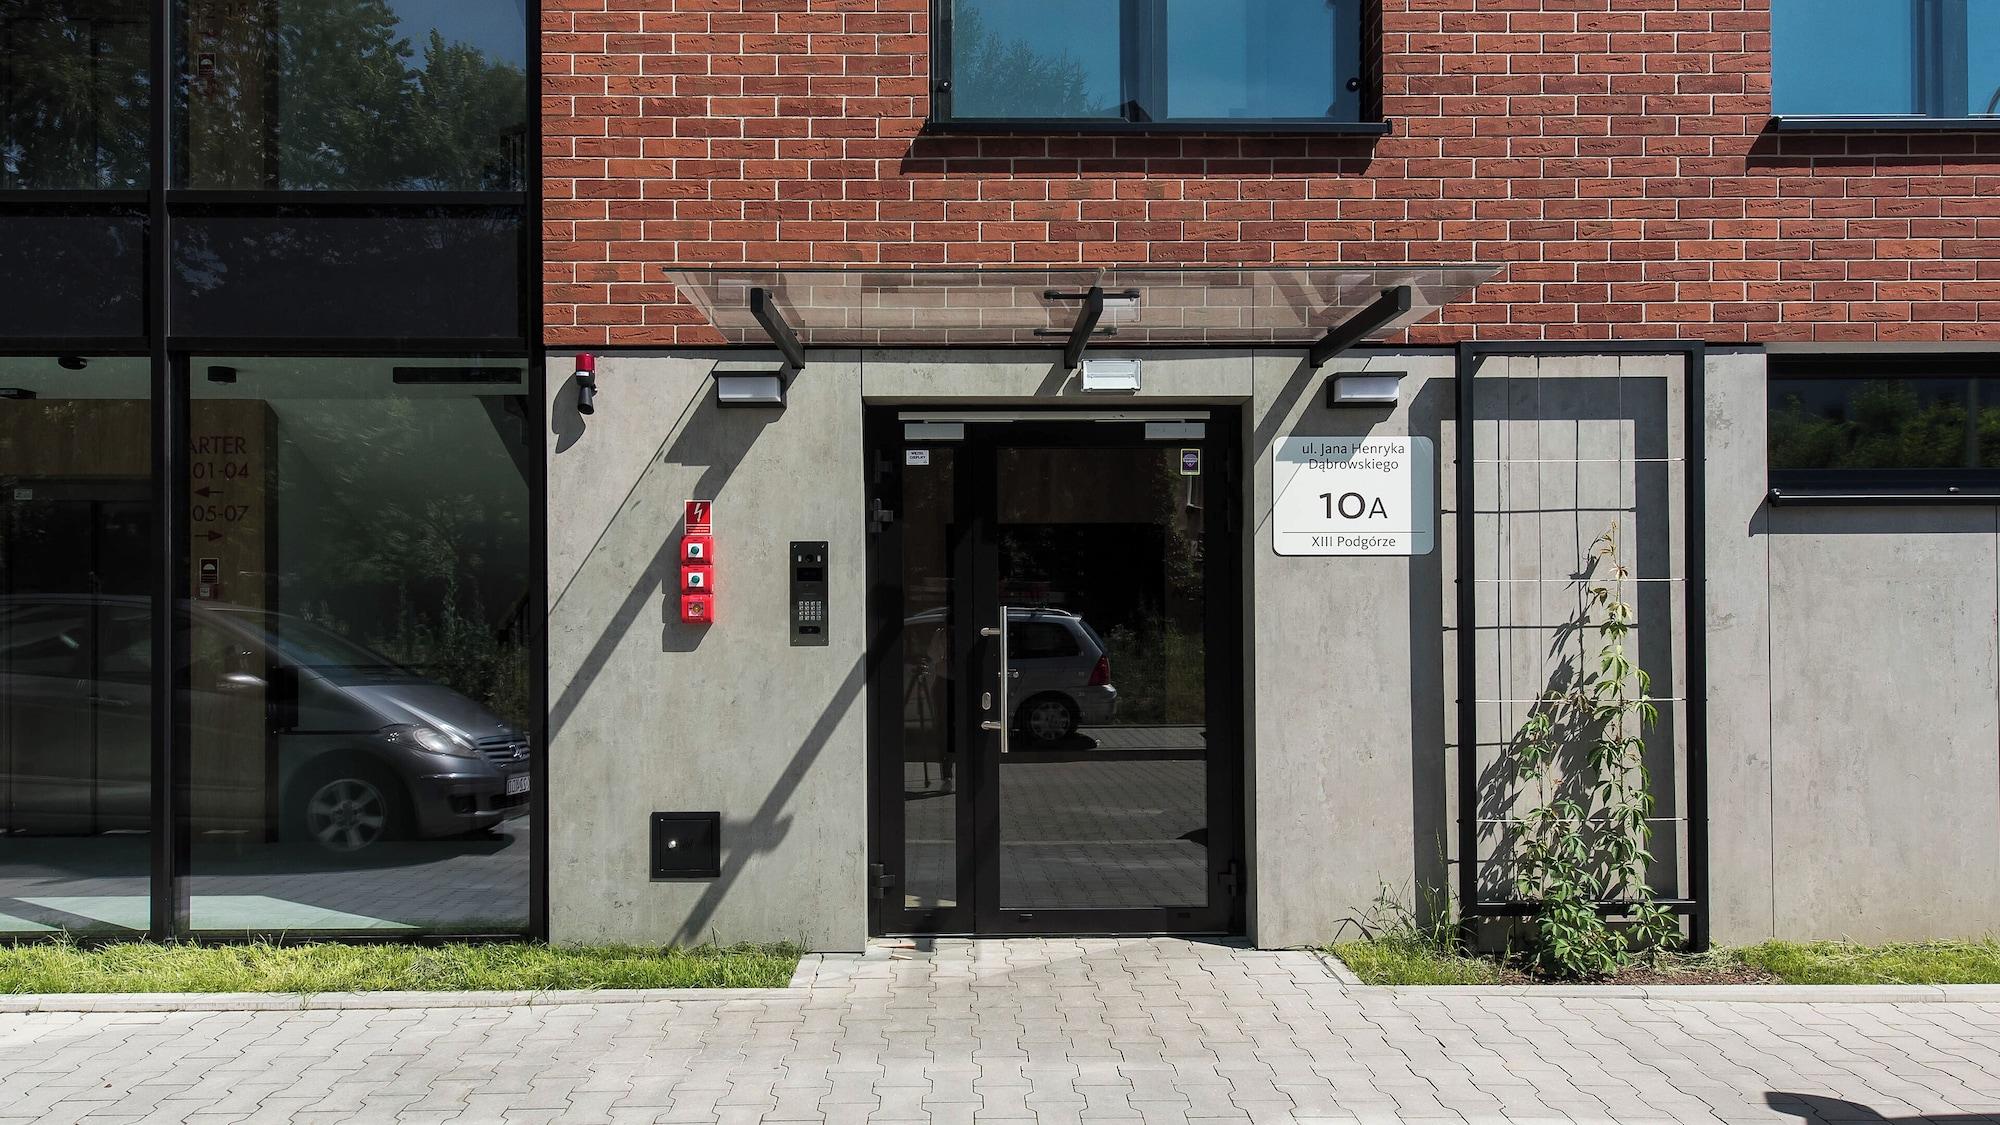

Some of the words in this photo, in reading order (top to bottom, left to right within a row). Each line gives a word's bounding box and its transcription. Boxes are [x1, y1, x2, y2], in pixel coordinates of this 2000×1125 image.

[1302, 442, 1317, 455] ul.
[1320, 442, 1348, 457] Jana
[1351, 442, 1405, 457] Henryka
[192, 462, 249, 479] 01-04
[1308, 458, 1399, 473] Dąbrowskiego
[192, 504, 249, 522] 05-07
[1319, 491, 1388, 520] 10A
[1311, 536, 1333, 547] XIII
[1337, 535, 1396, 550] Podgórze
